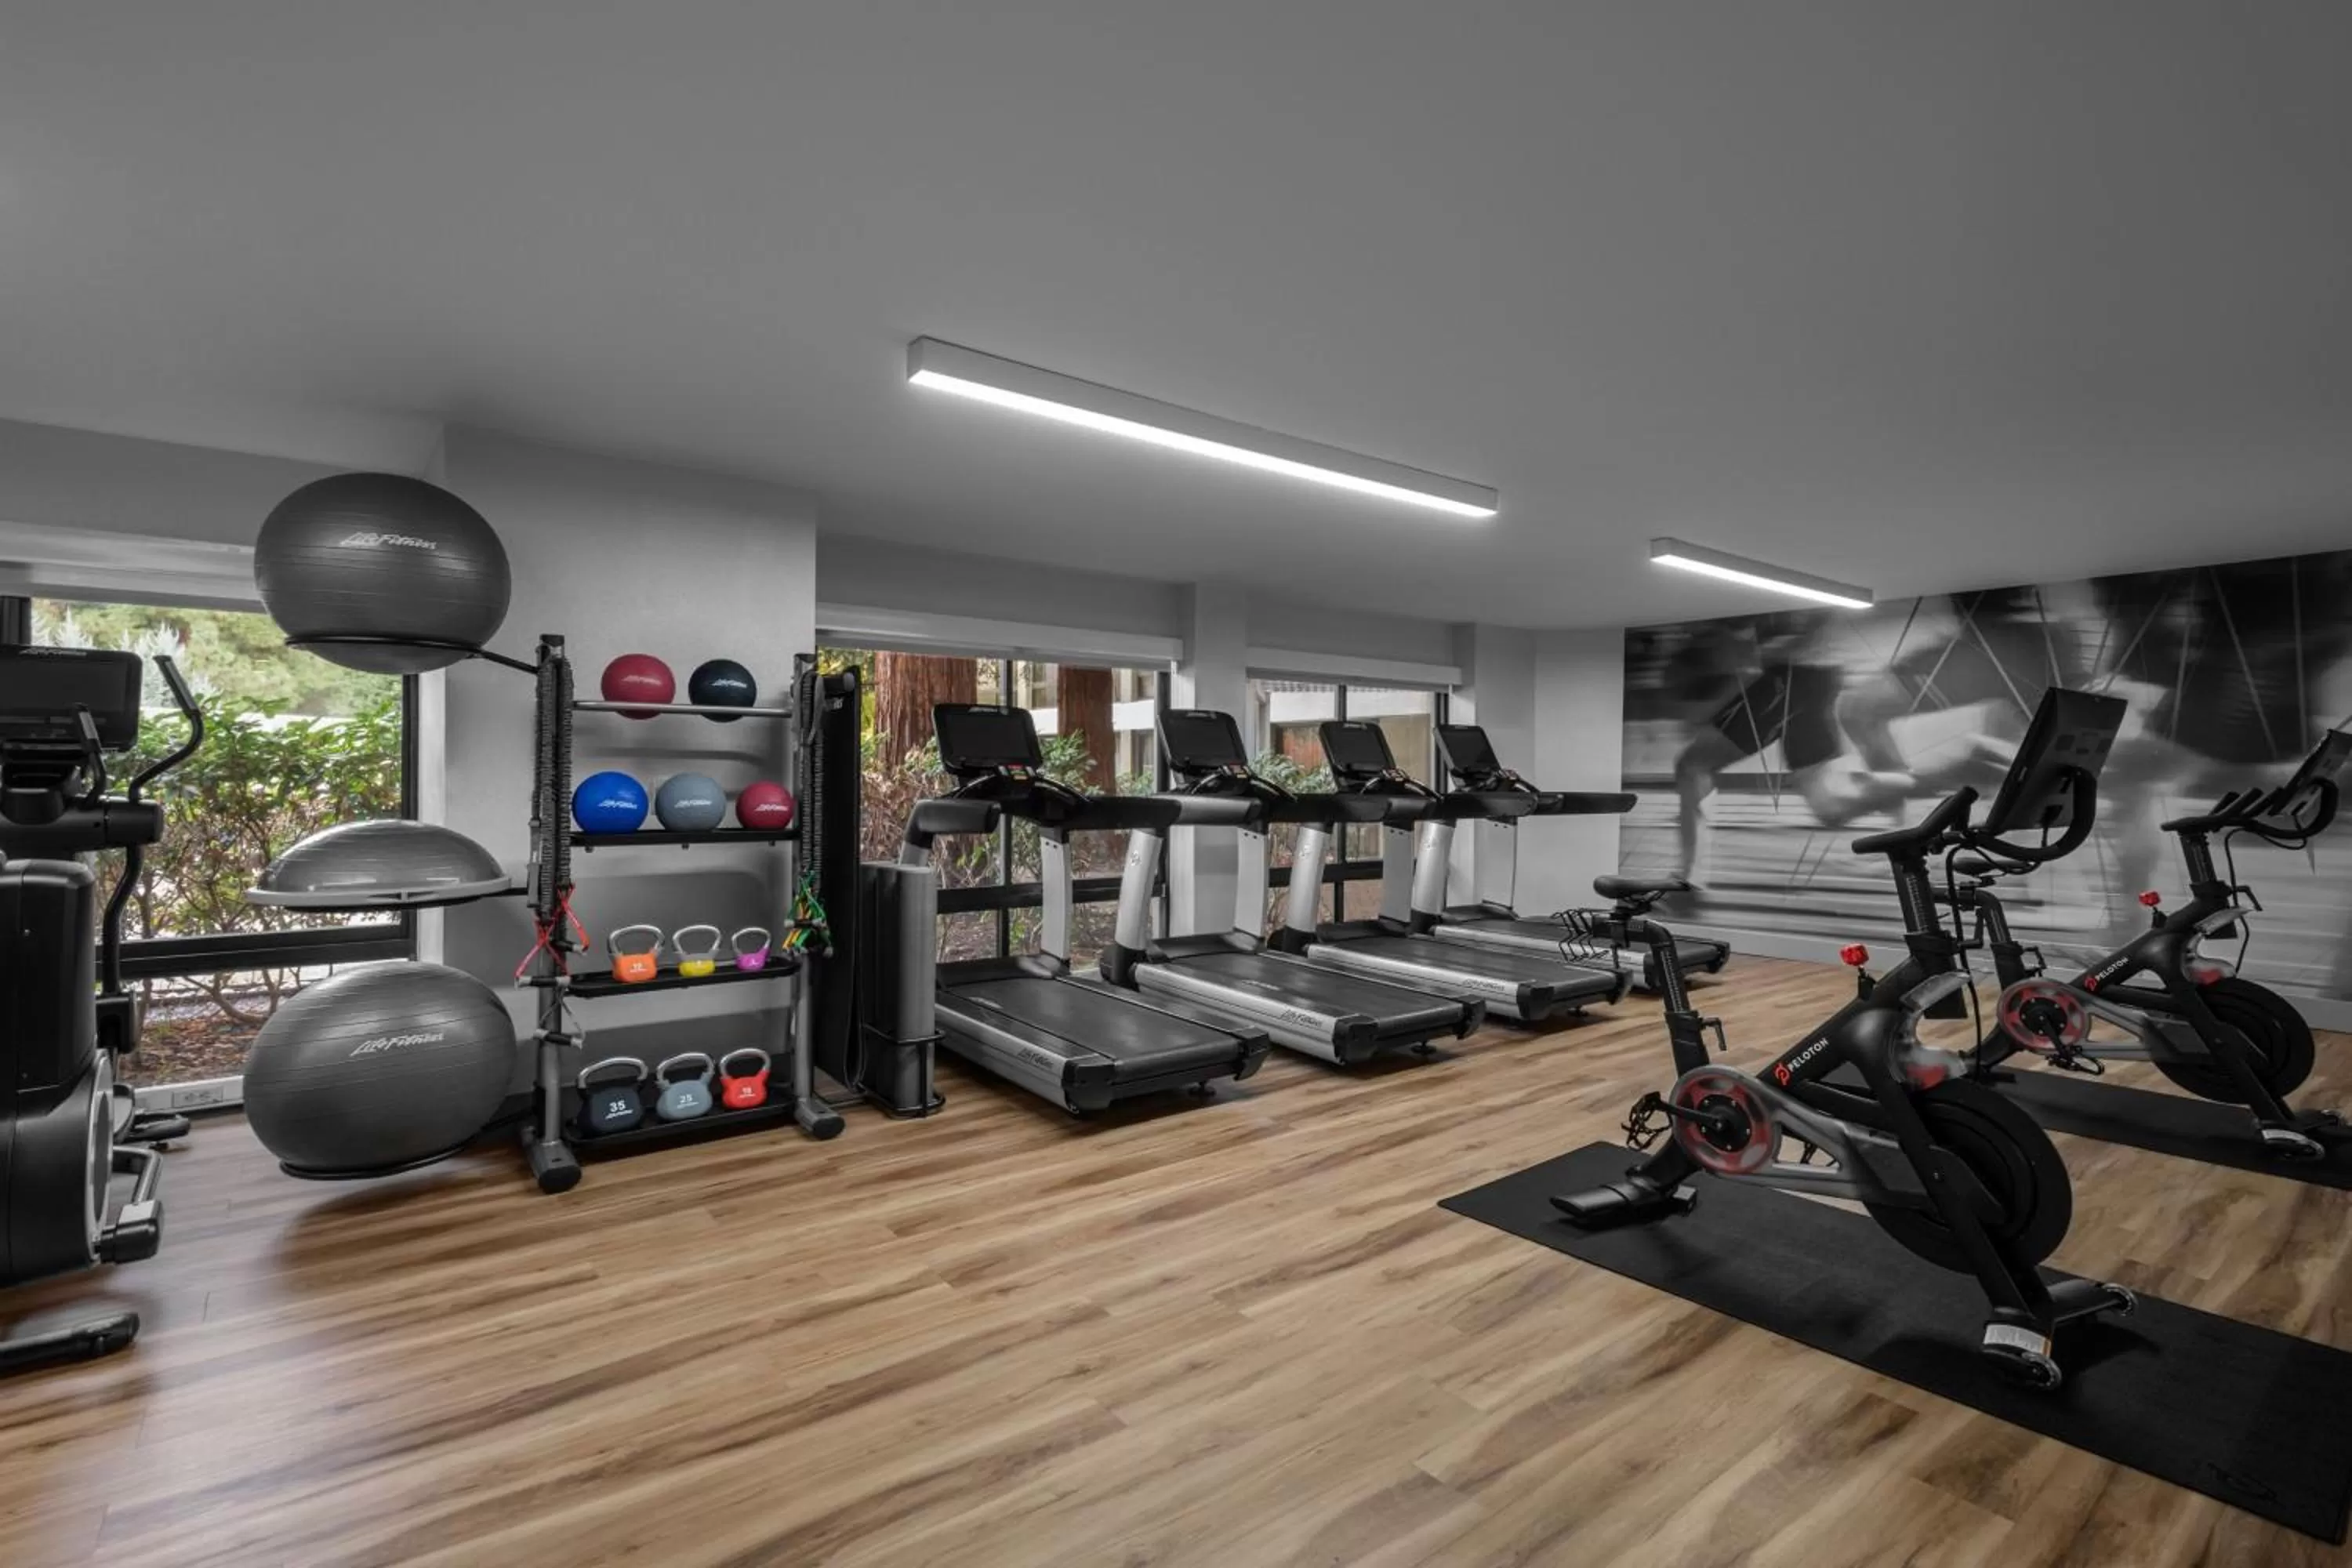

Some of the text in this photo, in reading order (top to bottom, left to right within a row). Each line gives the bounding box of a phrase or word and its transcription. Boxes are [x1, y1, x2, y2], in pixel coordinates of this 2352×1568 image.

[2095, 956, 2129, 982] PELOTON
[1788, 1037, 1829, 1073] PELOTON
[609, 1099, 626, 1112] 35
